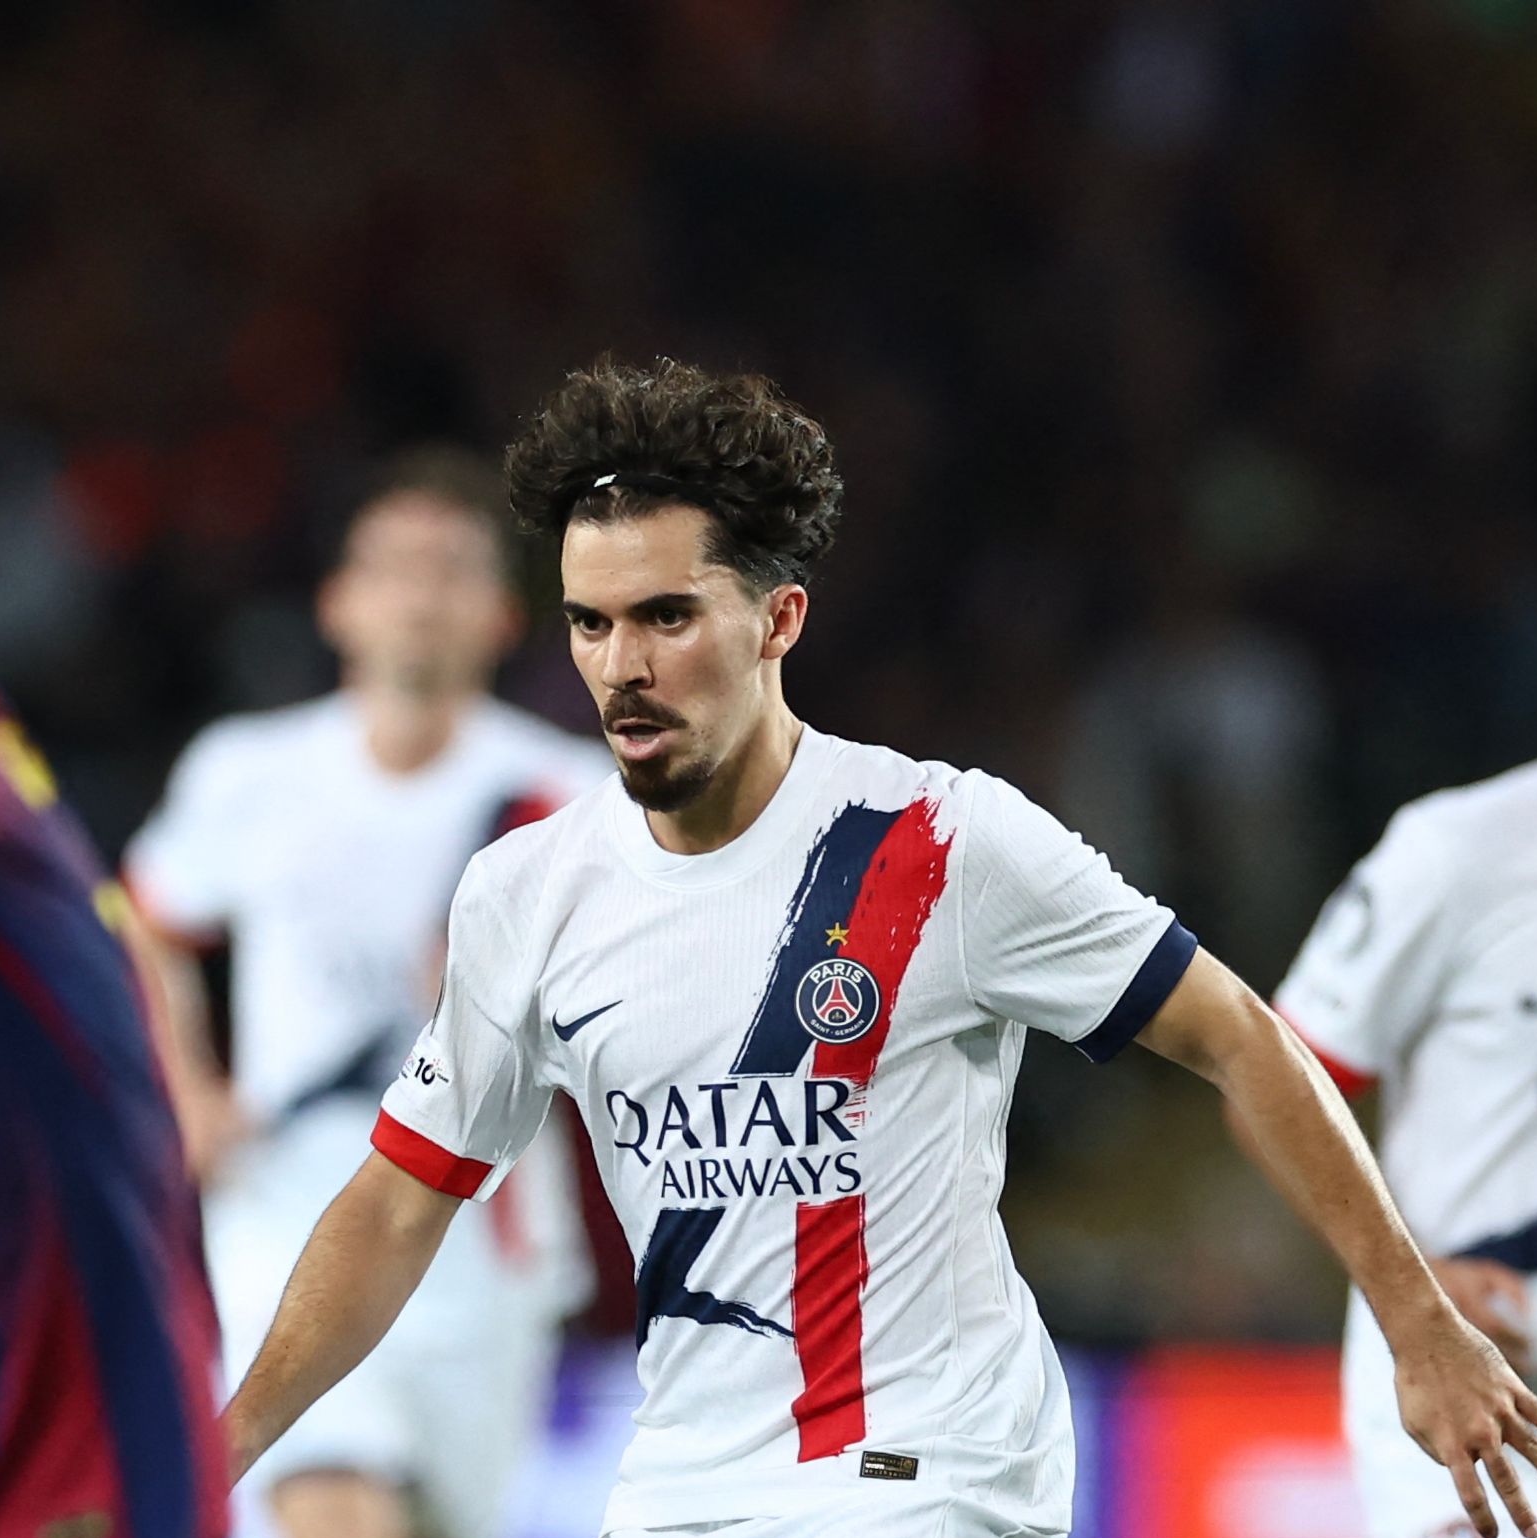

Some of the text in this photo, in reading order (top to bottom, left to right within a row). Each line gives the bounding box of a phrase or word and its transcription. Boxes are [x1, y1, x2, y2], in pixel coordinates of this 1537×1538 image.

[810, 963, 864, 984] PARIS
[414, 1057, 436, 1085] 10
[606, 1080, 857, 1167] QATAR
[661, 1152, 861, 1198] AIRWAYS
